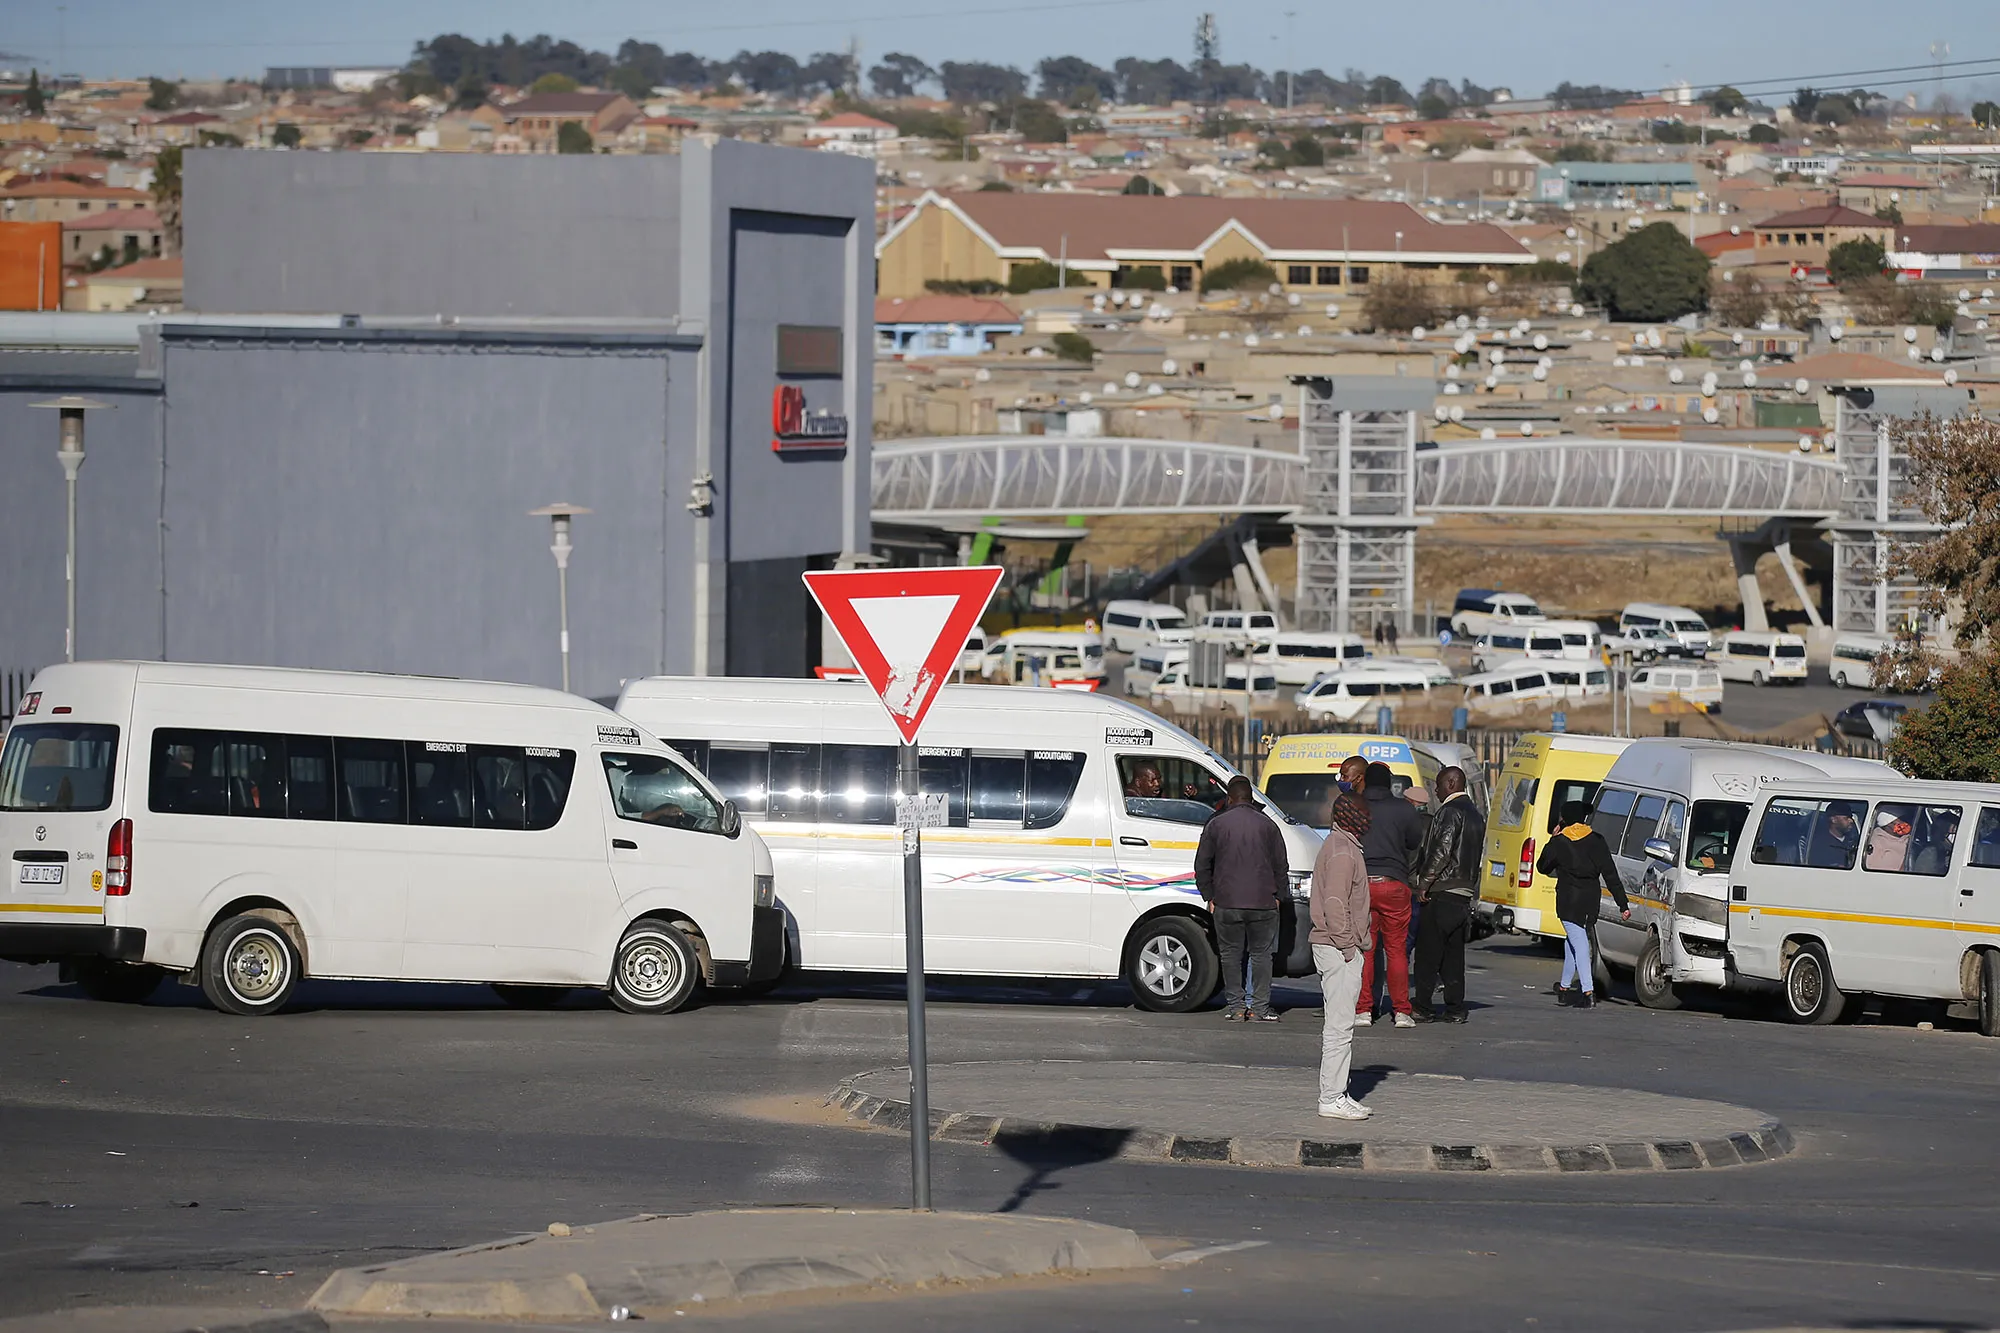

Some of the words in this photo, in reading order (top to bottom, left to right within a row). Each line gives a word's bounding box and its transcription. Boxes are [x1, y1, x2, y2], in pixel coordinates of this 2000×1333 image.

[599, 725, 632, 736] NOODUITGANG
[1107, 727, 1145, 736] NOODUITGANG
[599, 735, 628, 745] EMERGENCY
[629, 737, 640, 745] EXIT
[1107, 735, 1139, 745] EMERGENCY
[1140, 737, 1151, 746] EXIT
[426, 742, 456, 752] EMERGENCY
[457, 744, 467, 753] EXIT
[918, 747, 950, 757] EMERGENCY
[951, 748, 963, 757] EXIT
[1280, 743, 1298, 751] ONE
[1302, 743, 1325, 751] STOP
[1371, 746, 1400, 758] PEP
[525, 747, 560, 758] NOODUITGANG
[1034, 751, 1072, 761] NOODUITGANG
[1280, 751, 1296, 759] GET
[1298, 751, 1306, 759] IT
[1307, 751, 1324, 759] ALL
